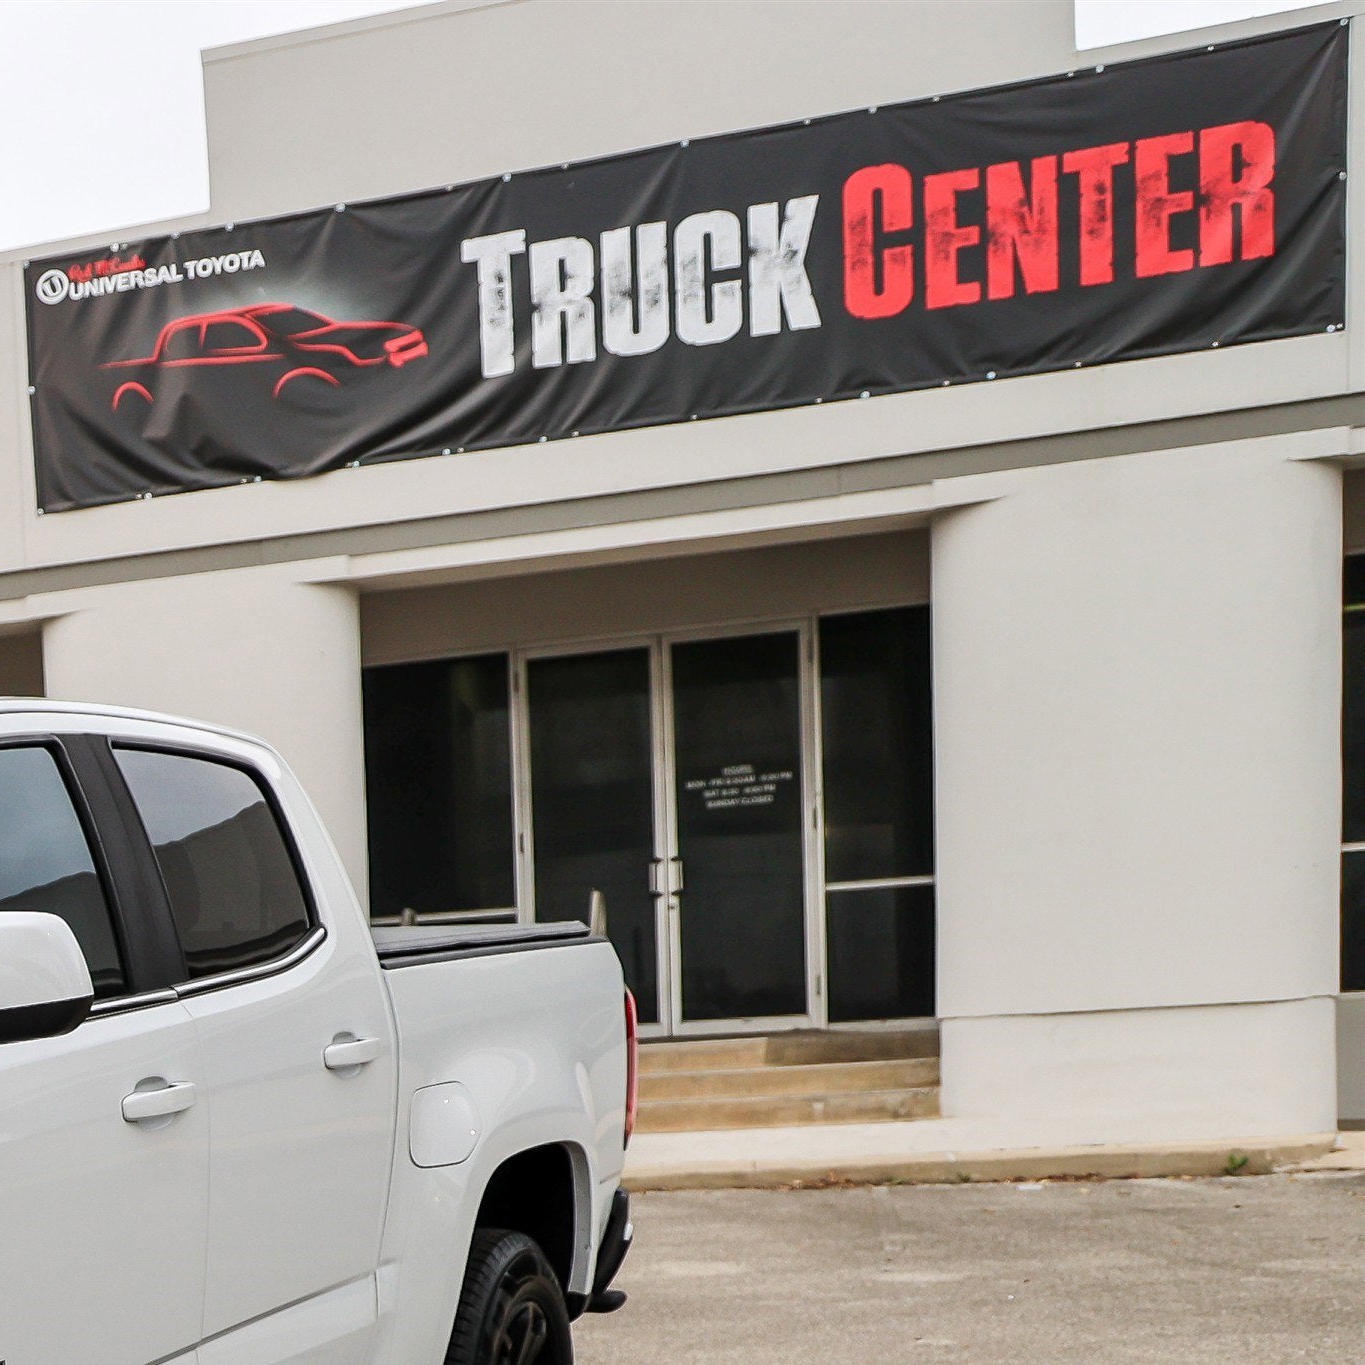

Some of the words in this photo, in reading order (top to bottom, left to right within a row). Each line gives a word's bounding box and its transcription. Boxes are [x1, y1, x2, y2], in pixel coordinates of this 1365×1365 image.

[69, 264, 184, 301] UNIVERSAL
[183, 249, 266, 280] TOYOTA
[461, 194, 822, 379] TRUCK
[841, 120, 1276, 320] CENTER
